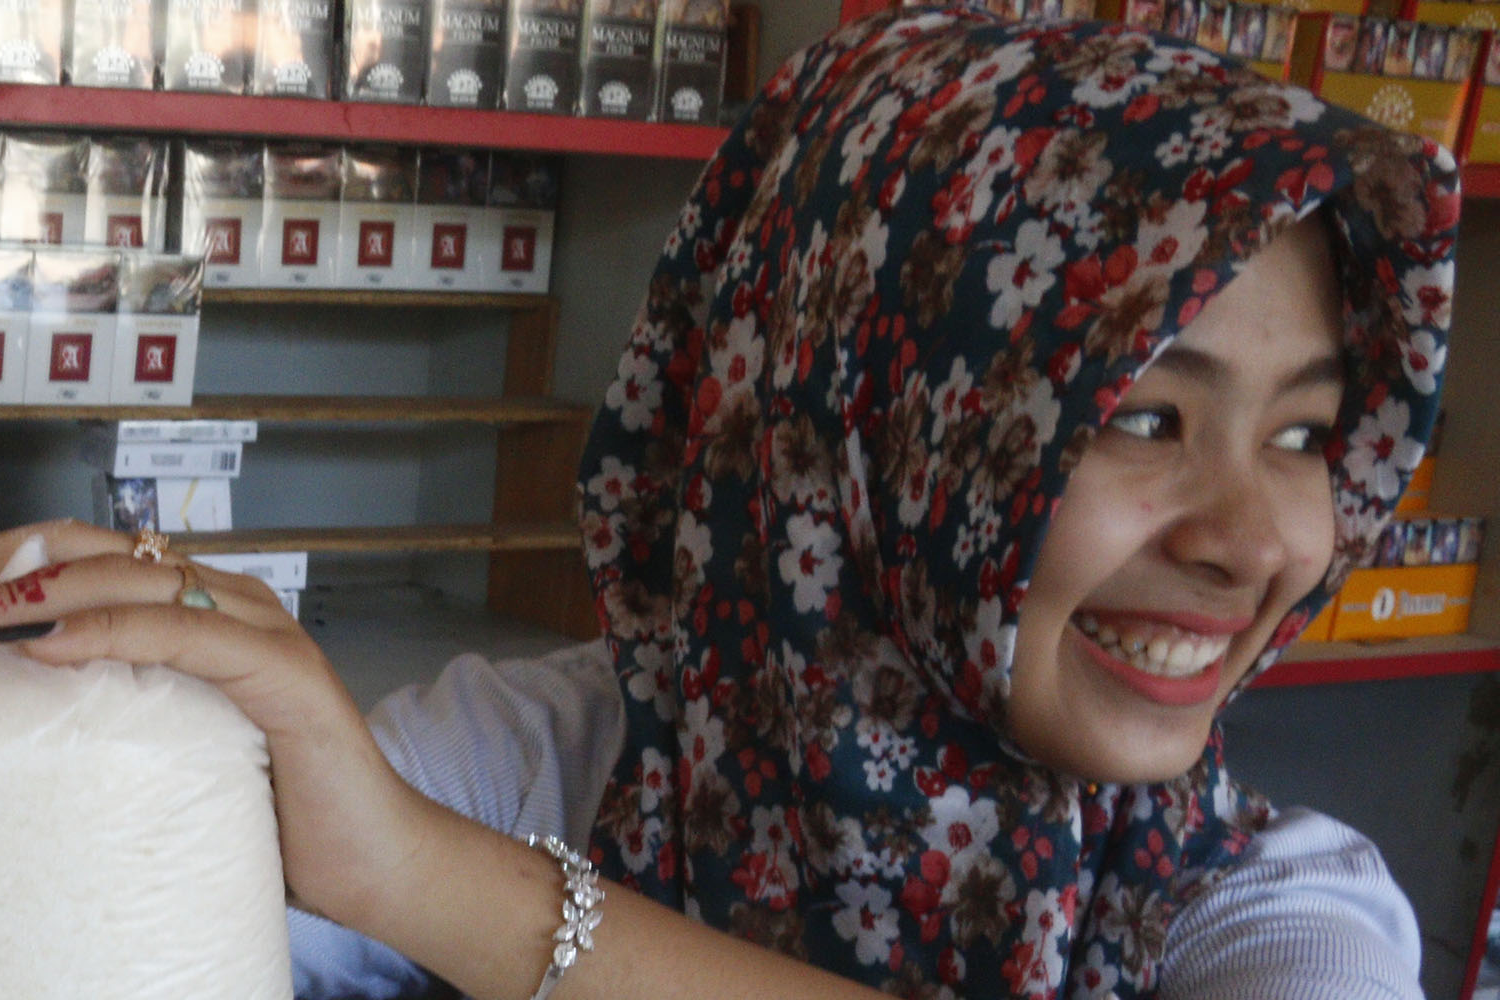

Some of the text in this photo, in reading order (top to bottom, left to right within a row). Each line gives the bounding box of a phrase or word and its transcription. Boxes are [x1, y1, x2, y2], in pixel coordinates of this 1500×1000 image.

[441, 12, 500, 31] MAGNUM
[518, 19, 576, 38] MAGNUM
[592, 25, 650, 46] MAGNUM
[666, 32, 721, 53] MAGNUM
